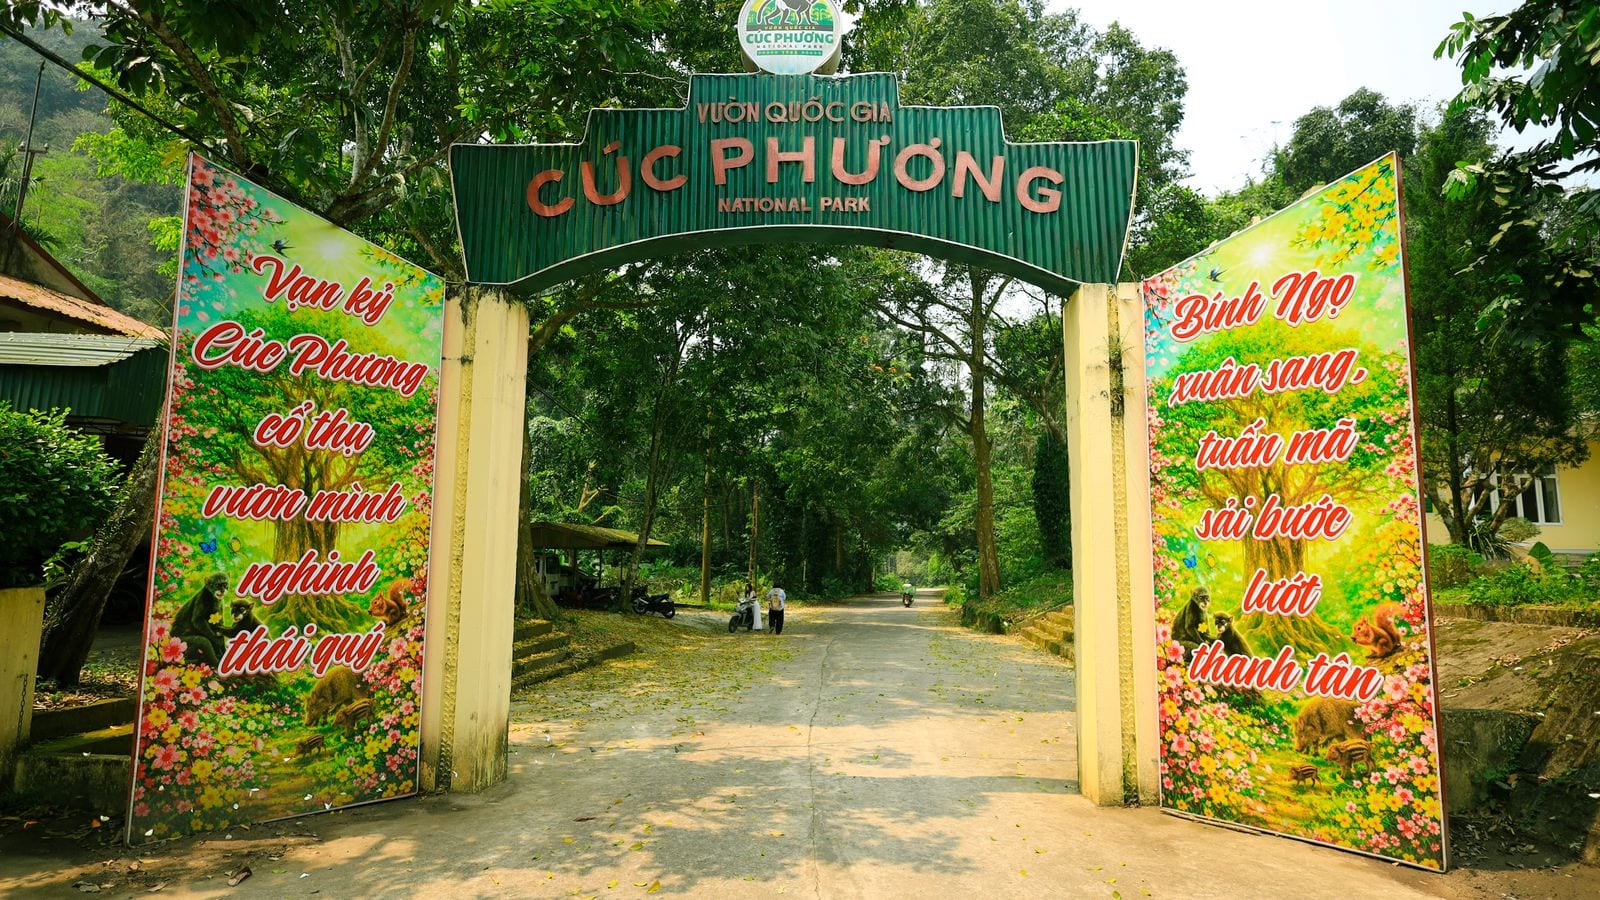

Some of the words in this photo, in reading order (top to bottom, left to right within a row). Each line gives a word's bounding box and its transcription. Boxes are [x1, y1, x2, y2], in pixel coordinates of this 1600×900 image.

[746, 30, 772, 44] CÚC
[774, 31, 834, 44] PHƯƠNG
[697, 96, 760, 123] VƯỜN
[765, 96, 845, 122] QUỐC
[850, 101, 892, 123] GIA
[527, 140, 688, 217] CÚC
[711, 135, 1064, 213] PHƯƠNG
[718, 197, 812, 212] NATIONAL
[820, 197, 870, 212] PARK
[251, 255, 344, 310] Vạn
[343, 277, 395, 325] kỷ
[1170, 281, 1266, 342] Bính
[1271, 270, 1357, 326] Ngọ
[193, 321, 286, 371] Cúc
[288, 334, 430, 398] Phương
[1168, 357, 1260, 407] xuân
[1260, 349, 1368, 394] sang,
[255, 400, 315, 447] cổ
[304, 409, 374, 456] thụ
[1196, 418, 1282, 471] tuấn
[1283, 418, 1359, 464] mã
[202, 483, 306, 520] vươn
[305, 482, 407, 522] mình
[1194, 497, 1253, 540] sải
[1253, 493, 1351, 540] bước
[236, 549, 380, 604] nghinh
[1242, 568, 1323, 616] lướt
[218, 624, 317, 677] thái
[311, 622, 386, 677] quý
[1187, 641, 1302, 691] thanh
[1304, 653, 1384, 702] tân
